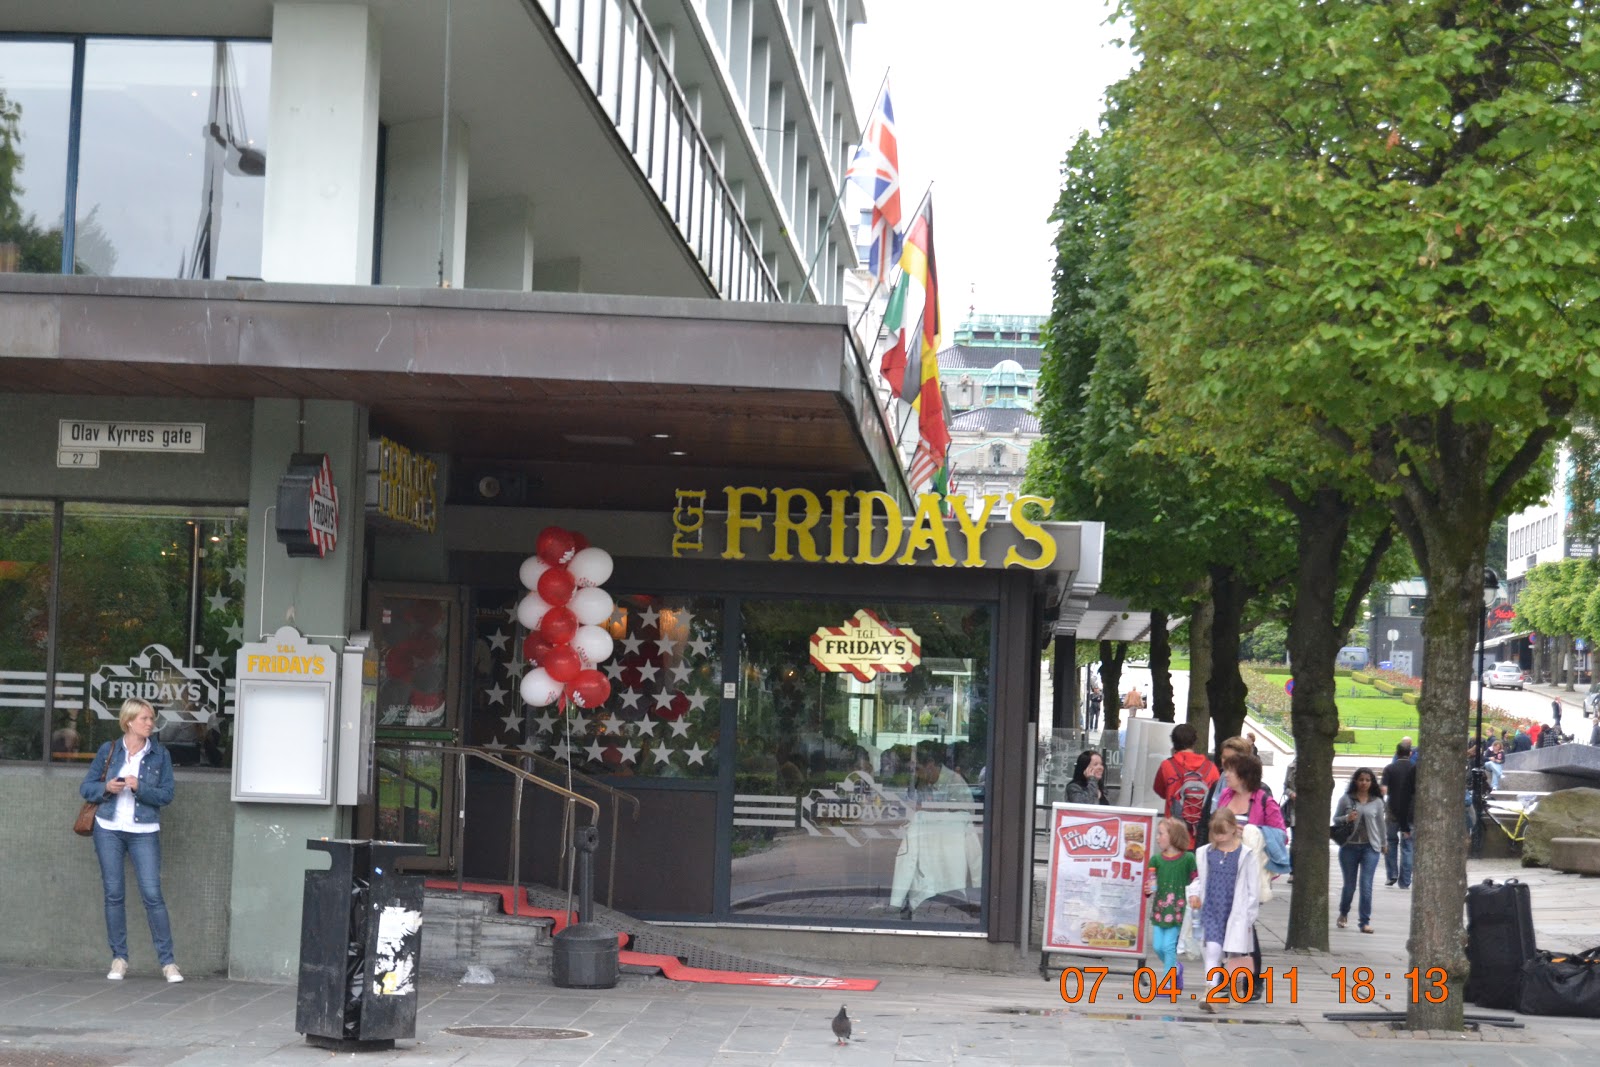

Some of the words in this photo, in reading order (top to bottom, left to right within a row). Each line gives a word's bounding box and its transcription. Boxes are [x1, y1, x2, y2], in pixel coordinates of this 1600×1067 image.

[71, 423, 100, 441] Olav
[108, 424, 154, 447] Kyrres
[162, 429, 191, 447] gate
[72, 453, 84, 464] 27
[672, 488, 706, 558] TGI
[720, 485, 1057, 570] FRIDAY'S
[825, 639, 906, 656] FRIDAY'S
[144, 669, 166, 682] T.G.I.
[108, 681, 201, 702] FRIDAY'S
[816, 802, 899, 820] FRIDAY'S
[1067, 832, 1117, 851] LUNCH!
